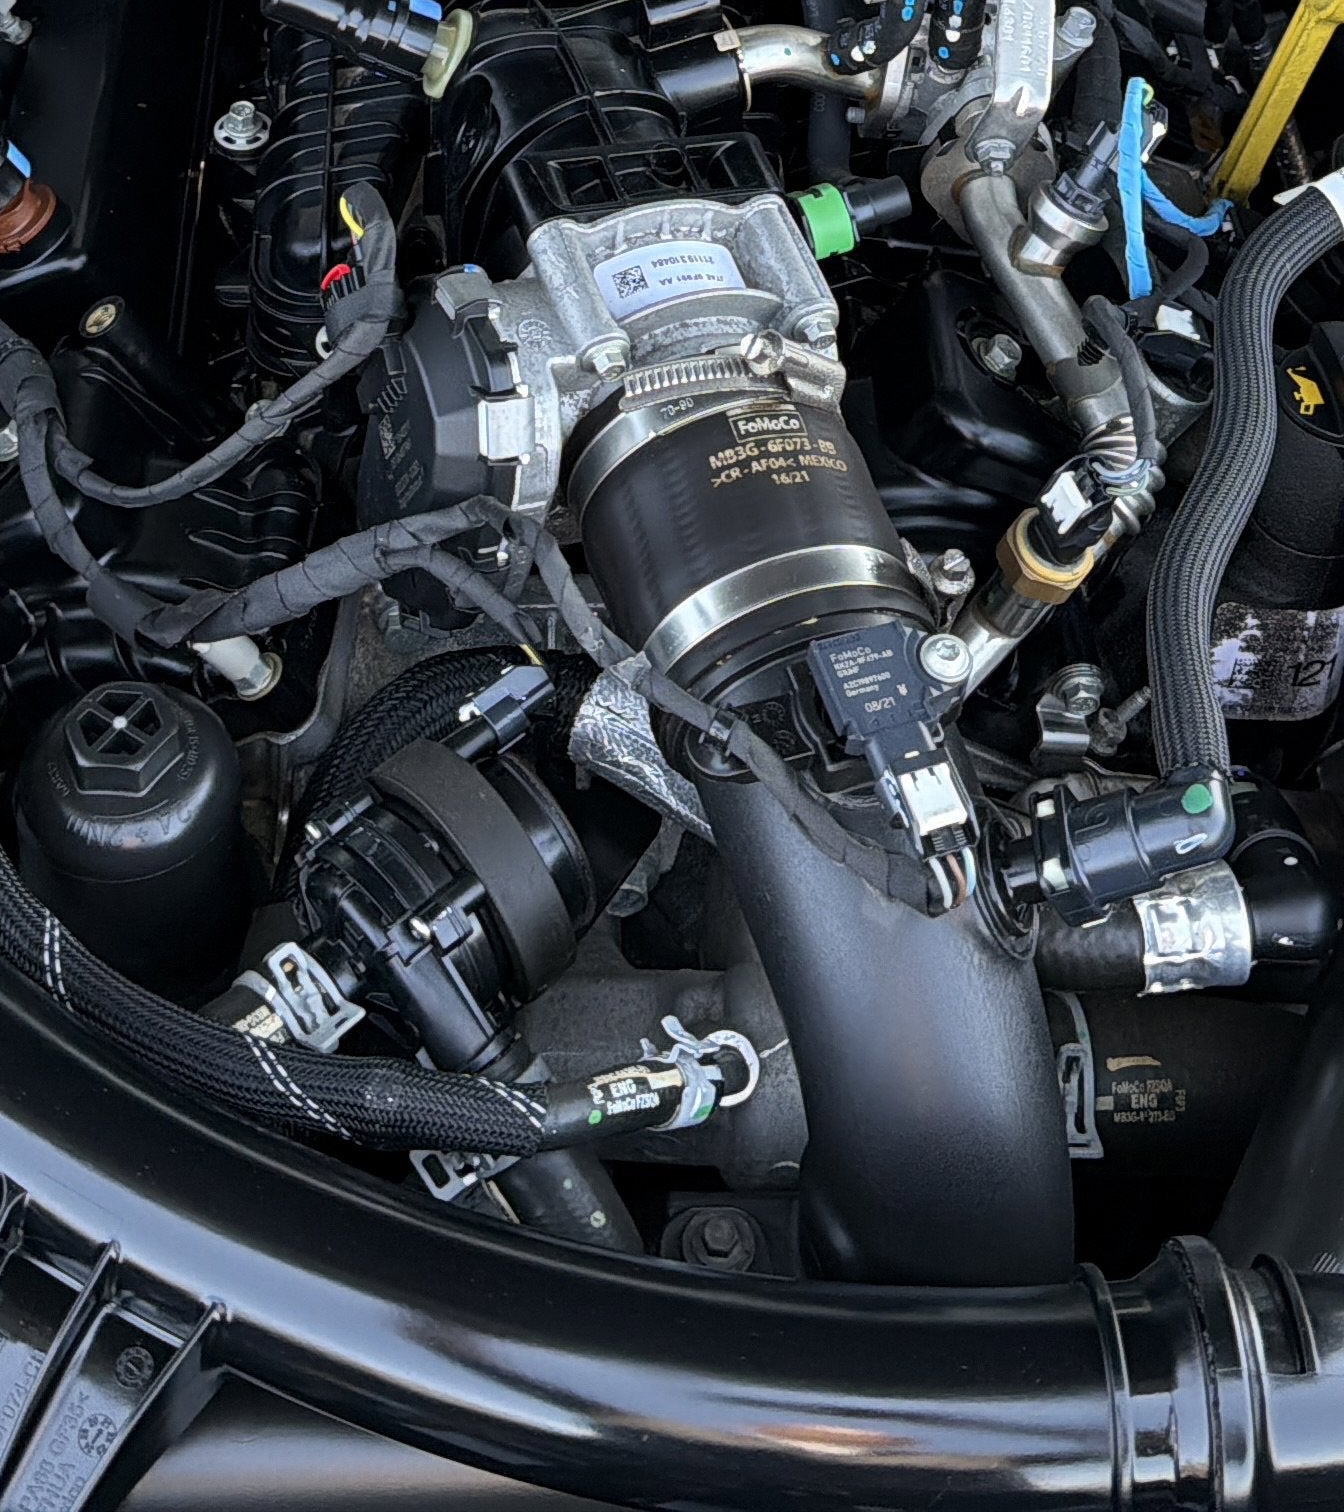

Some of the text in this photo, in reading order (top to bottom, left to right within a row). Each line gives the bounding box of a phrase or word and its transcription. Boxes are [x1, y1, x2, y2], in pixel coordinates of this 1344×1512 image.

[658, 277, 673, 287] AA
[737, 416, 800, 435] FoMoCo
[798, 454, 848, 472] MEXICO
[770, 470, 811, 486] 16/21
[829, 646, 872, 663] FoMoCo
[845, 684, 880, 698] Germany
[864, 696, 896, 713] 08/21
[607, 1075, 638, 1101] ENG
[1130, 1093, 1158, 1109] ENG
